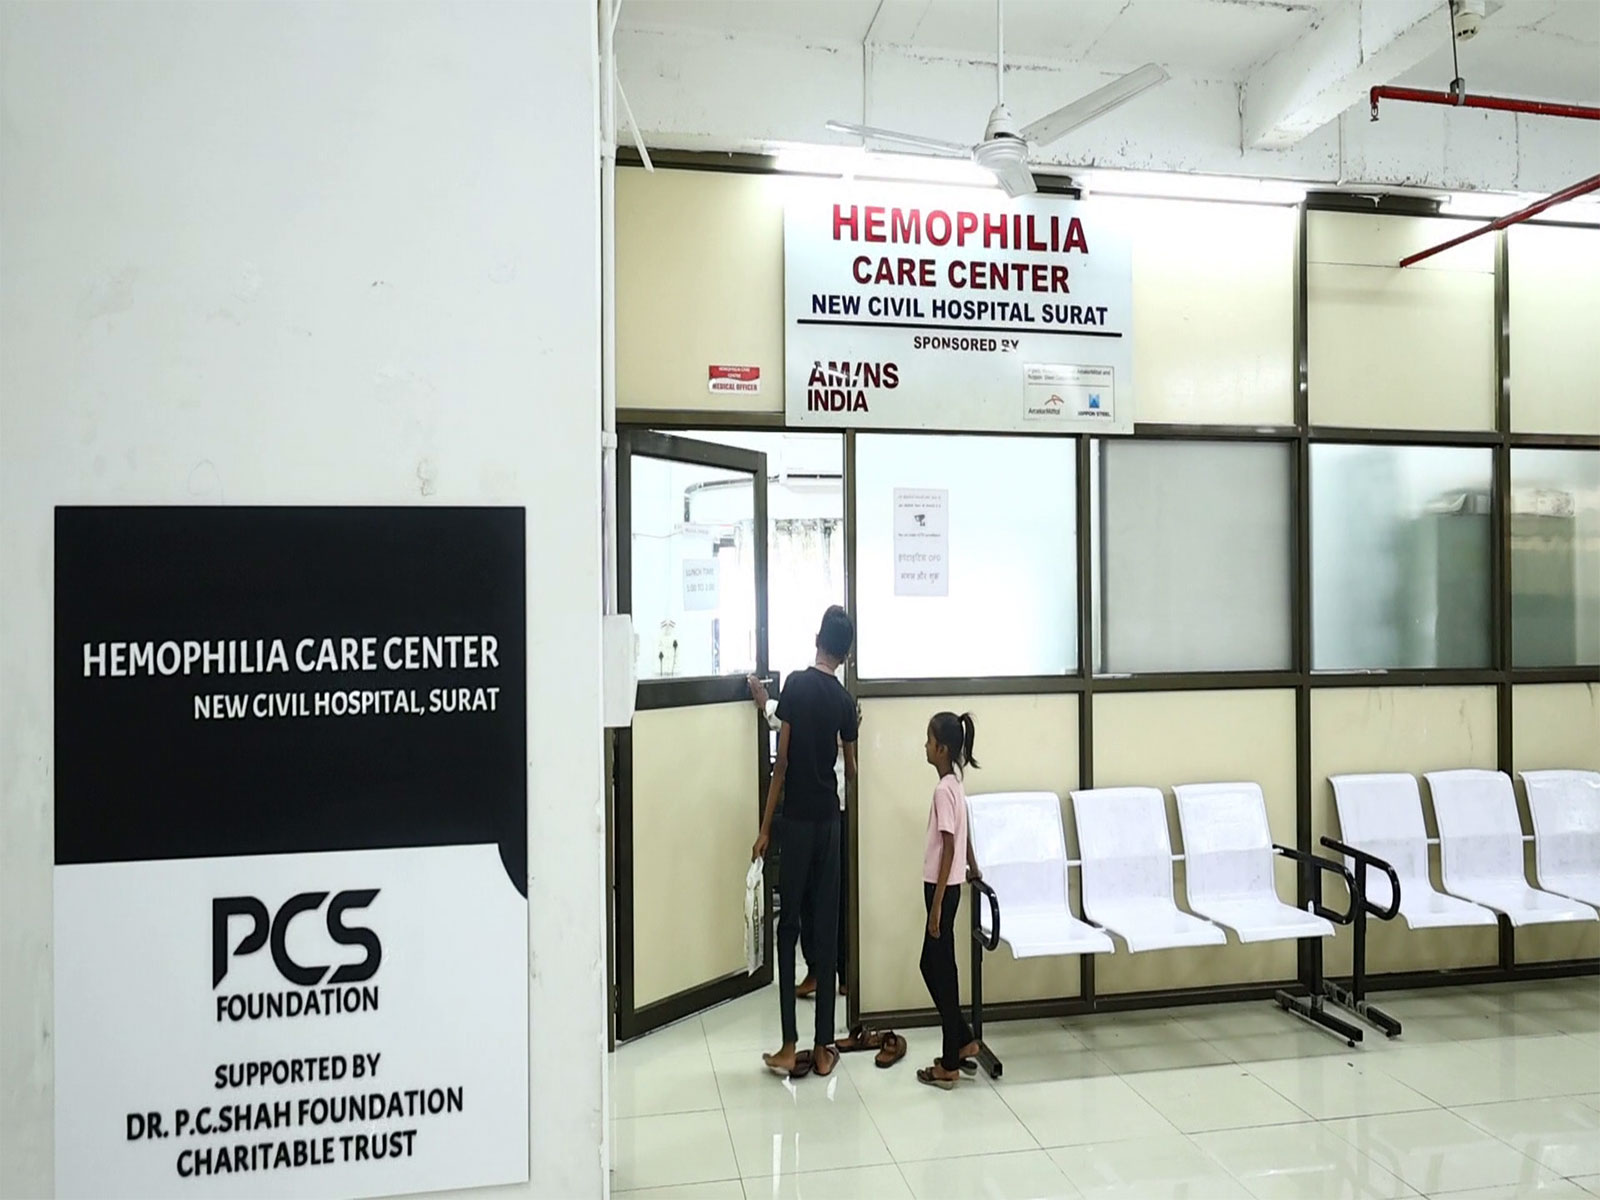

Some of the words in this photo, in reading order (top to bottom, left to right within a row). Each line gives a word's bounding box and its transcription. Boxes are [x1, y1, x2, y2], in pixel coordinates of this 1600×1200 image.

[833, 203, 1089, 254] HEMOPHILIA
[853, 256, 936, 287] CARE
[948, 260, 1070, 293] CENTER
[812, 294, 861, 315] NEW
[868, 297, 925, 318] CIVIL
[932, 299, 1035, 322] HOSPITAL
[1042, 304, 1108, 325] SURAT
[914, 336, 997, 352] SPONSORED
[1001, 339, 1020, 352] BY
[807, 389, 869, 412] INDIA
[83, 639, 289, 678] HEMOPHILIA
[295, 637, 377, 673] CARE
[383, 635, 499, 670] CENTER
[194, 694, 248, 720] NEW
[252, 692, 309, 718] CIVIL
[314, 689, 425, 717] HOSPITAL,
[429, 687, 499, 713] SURAT
[212, 888, 382, 991] PCS
[216, 986, 379, 1022] FOUNDATION
[214, 1056, 347, 1089] SUPPORTED
[352, 1053, 381, 1078] BY
[126, 1112, 168, 1140] DR.
[175, 1101, 291, 1136] P.C.SHAH
[298, 1086, 463, 1128] FOUNDATION
[176, 1136, 334, 1178] CHARITABLE
[339, 1129, 417, 1163] TRUST
